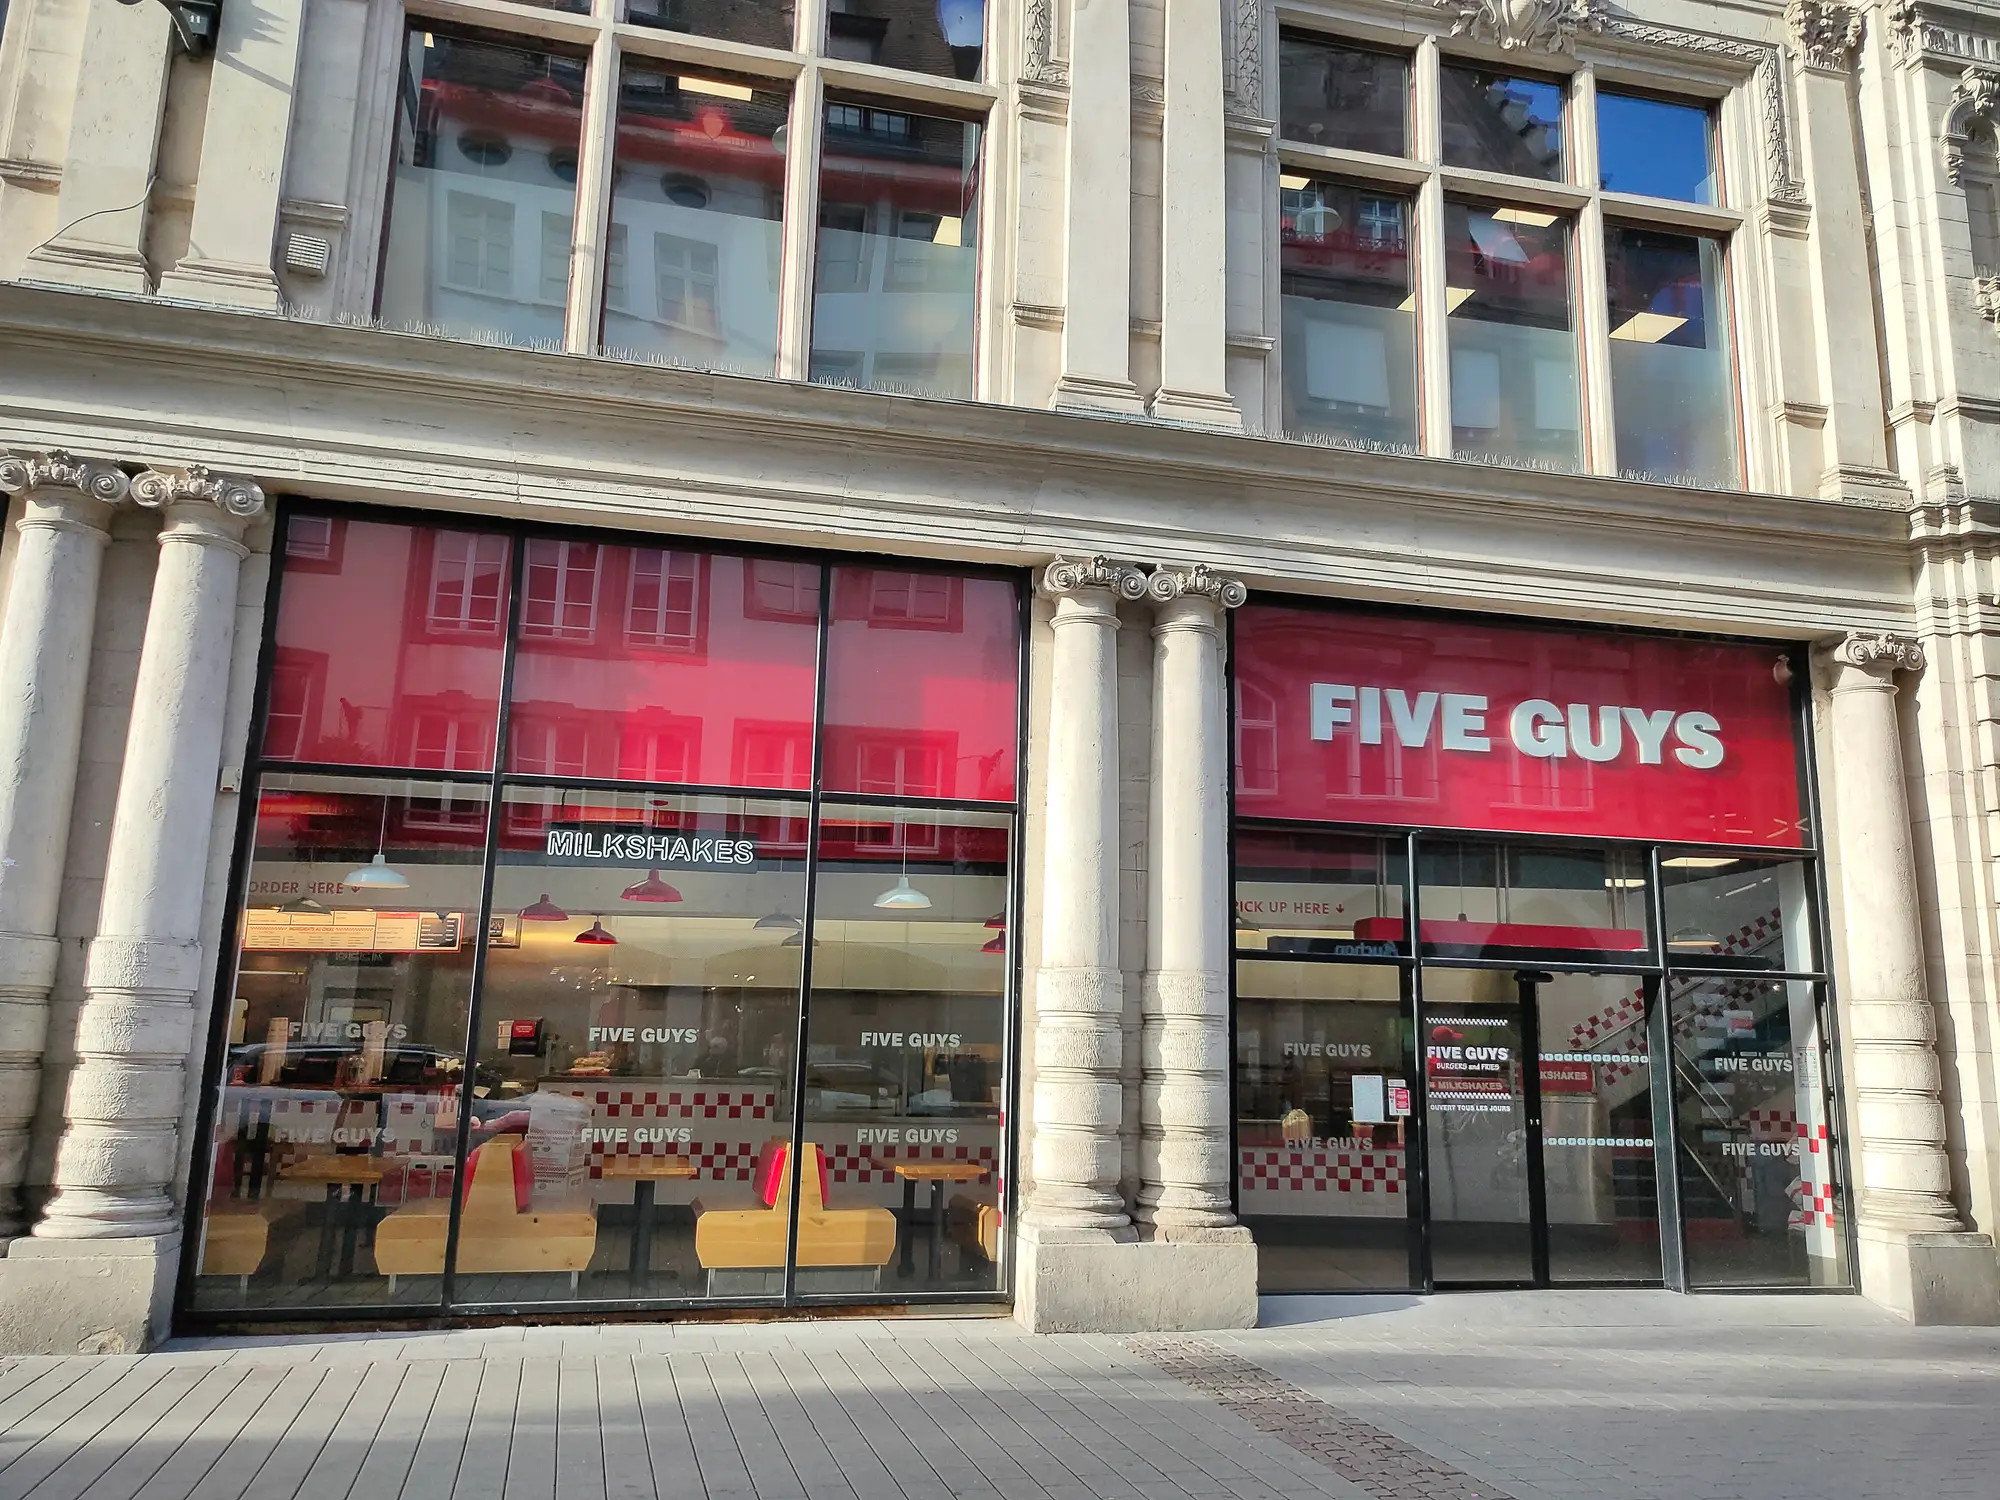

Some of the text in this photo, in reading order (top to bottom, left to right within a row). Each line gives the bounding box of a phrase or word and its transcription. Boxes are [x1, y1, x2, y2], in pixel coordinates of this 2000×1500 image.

[1310, 683, 1725, 769] FIVE GUYS
[547, 831, 754, 864] MILKSHAKES
[248, 881, 299, 894] ORDER
[1269, 902, 1287, 913] UP
[1293, 902, 1329, 914] HERE
[288, 1022, 408, 1039] FIVE GUYS
[589, 1027, 697, 1043] FIVE GUYS
[861, 1032, 960, 1048] FIVE GUYS
[1283, 1043, 1372, 1058] FIVE GUYS
[1427, 1046, 1508, 1061] FIVE GUYS
[1714, 1058, 1793, 1072] FIVE GUYS
[1540, 1071, 1588, 1081] KSHAKES
[1438, 1081, 1504, 1091] MILKSHAKES
[274, 1128, 396, 1147] FIVE GUYS
[581, 1127, 692, 1143] FIVE GUYS
[857, 1128, 958, 1143] FIVE GUYS
[1285, 1136, 1373, 1150] FIVE GUYS
[1722, 1143, 1801, 1156] FIVE GUYS
